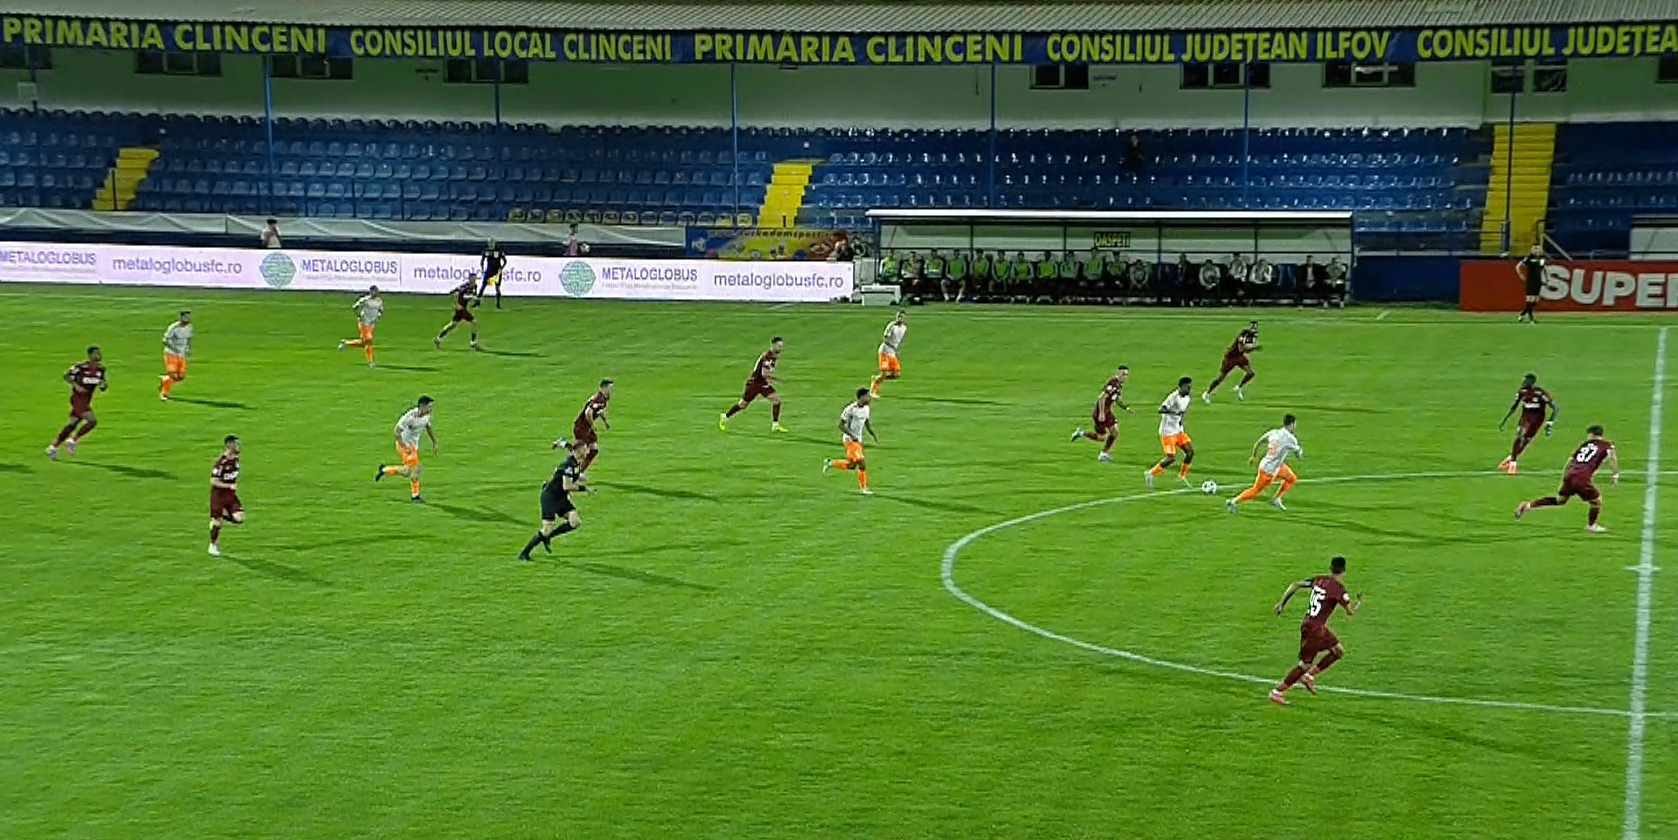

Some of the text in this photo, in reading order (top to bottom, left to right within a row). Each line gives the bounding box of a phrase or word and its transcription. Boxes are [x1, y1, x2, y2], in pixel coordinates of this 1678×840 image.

[175, 25, 326, 53] CLINCENI
[350, 29, 671, 60] CONSILIUL LOCAL CLINCENI
[866, 34, 1022, 62] CLINCENI
[1047, 34, 1174, 62] CONSILIUL
[1316, 31, 1390, 59] ILFOV
[1417, 28, 1554, 58] CONSILIUL
[112, 256, 243, 274] metaloglobusfc.ro
[302, 259, 398, 274] METALOGLOBUS
[413, 265, 542, 282] metaloglosfc.ro
[602, 266, 698, 282] METALOGLOBUS
[714, 271, 844, 289] metaloglobusfc.ro
